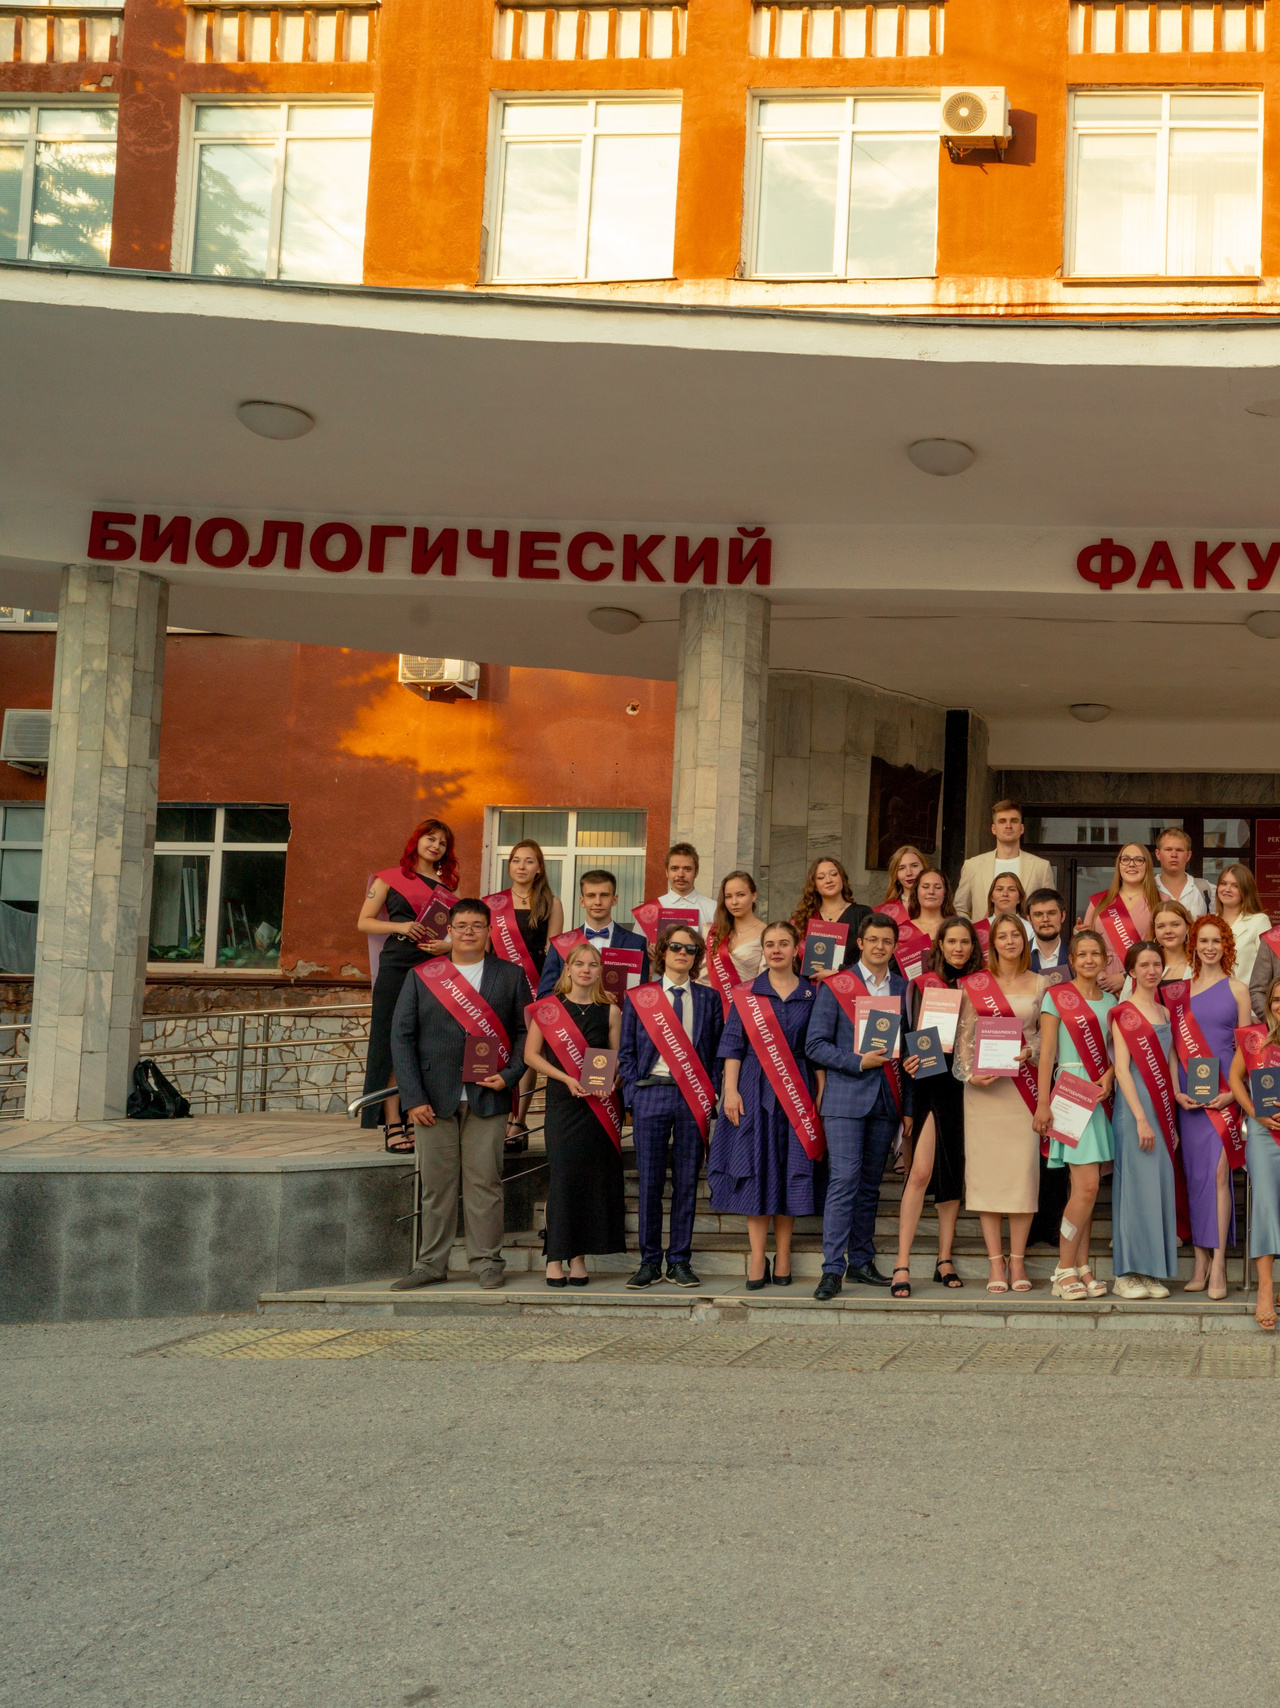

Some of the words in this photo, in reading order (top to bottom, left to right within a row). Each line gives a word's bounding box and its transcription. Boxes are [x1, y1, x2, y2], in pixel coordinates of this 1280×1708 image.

[87, 510, 773, 586] БИОЛОГИЧЕСКИЙ
[496, 915, 522, 966] ЛУЧШИЙ
[1108, 908, 1135, 950] ЛУЧШИЙ
[440, 978, 482, 1020] ЛУЧШИЙ
[555, 1027, 584, 1073] ЛУЧШИ
[653, 1012, 687, 1062] ЛУЧШИЙ
[1074, 1014, 1102, 1067] ЛУЧШИЙ
[1175, 1004, 1200, 1054] ЛУЧШИЙ
[745, 995, 773, 1044] ЛУЧШИЙ
[766, 1044, 807, 1117] ВЫПУСКНИК
[801, 1116, 817, 1141] 2024
[1137, 1035, 1167, 1089] ЛУЧШИЙ
[1059, 1085, 1093, 1104] БЛАГОДАРНОСТЬ
[1228, 1126, 1243, 1151] 2024
